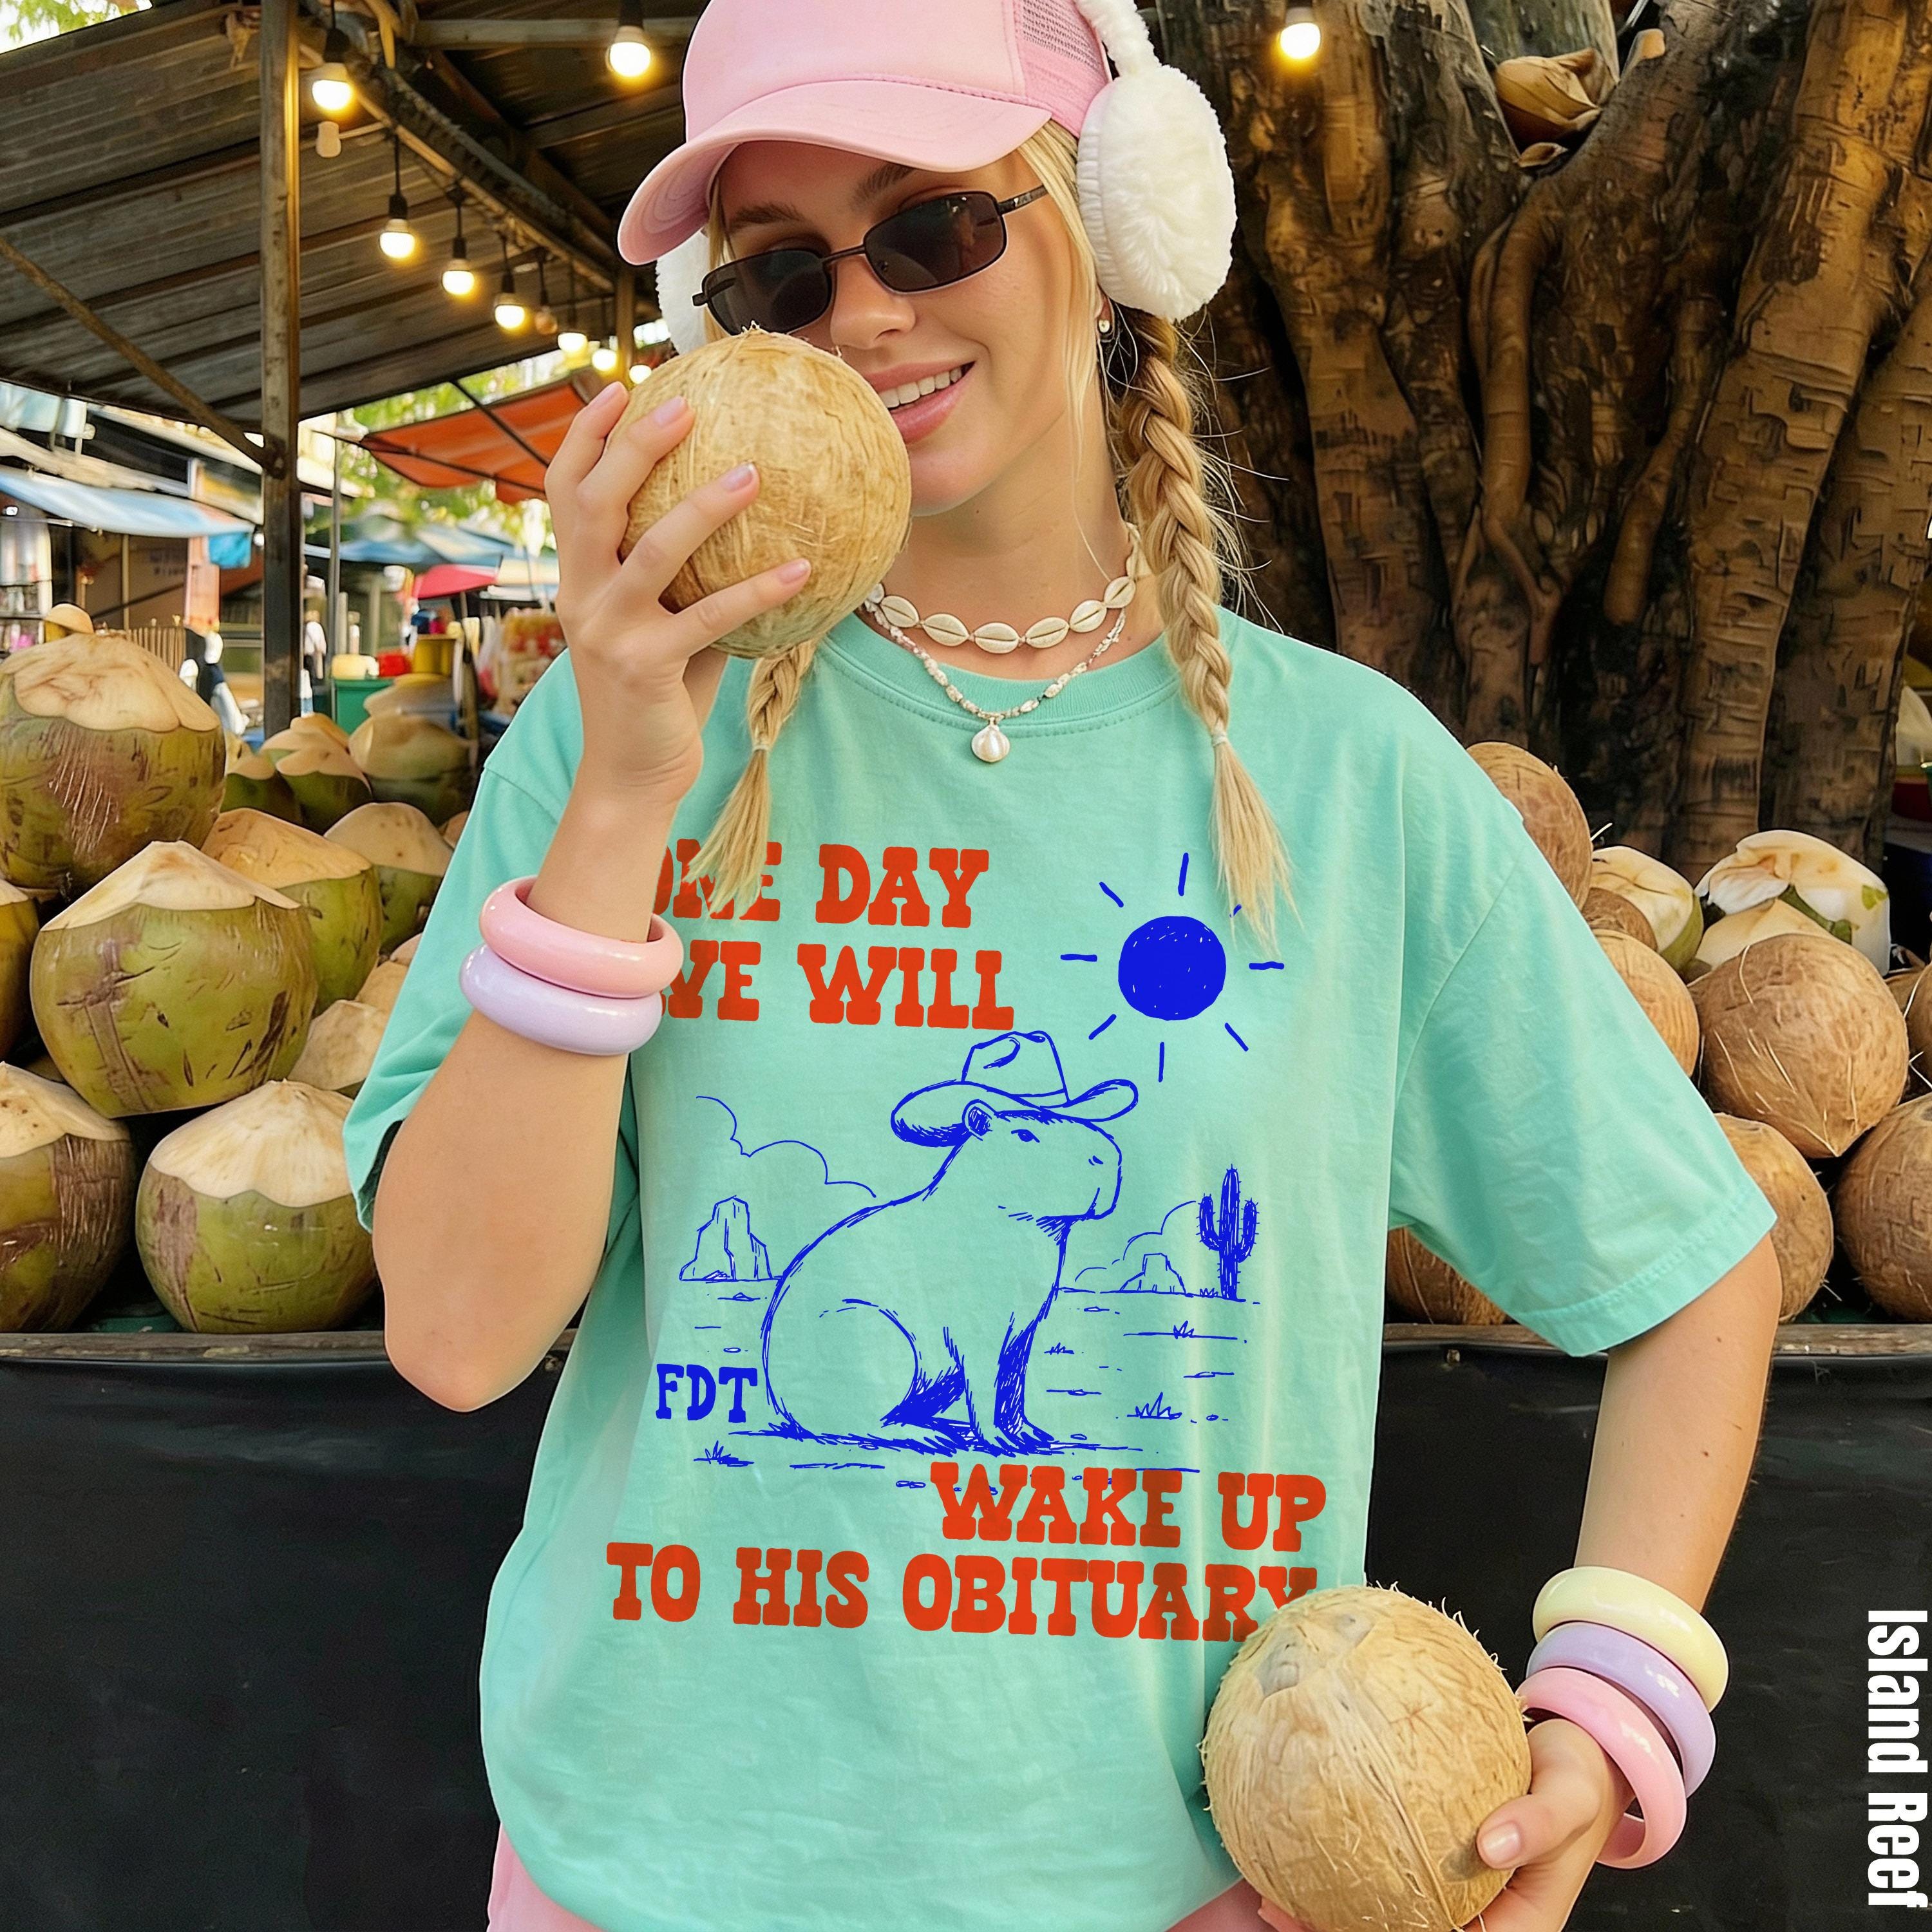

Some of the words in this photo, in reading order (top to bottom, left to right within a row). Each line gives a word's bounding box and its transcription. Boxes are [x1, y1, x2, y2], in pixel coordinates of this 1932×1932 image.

[816, 844, 989, 928] DAY
[797, 944, 1014, 1030] WILL
[656, 1363, 758, 1423] FDT
[931, 1461, 1182, 1547] WAKE
[1218, 1472, 1327, 1552] UP
[607, 1542, 701, 1622] TO
[733, 1547, 869, 1628] HIS
[902, 1553, 1318, 1642] OBITUARY
